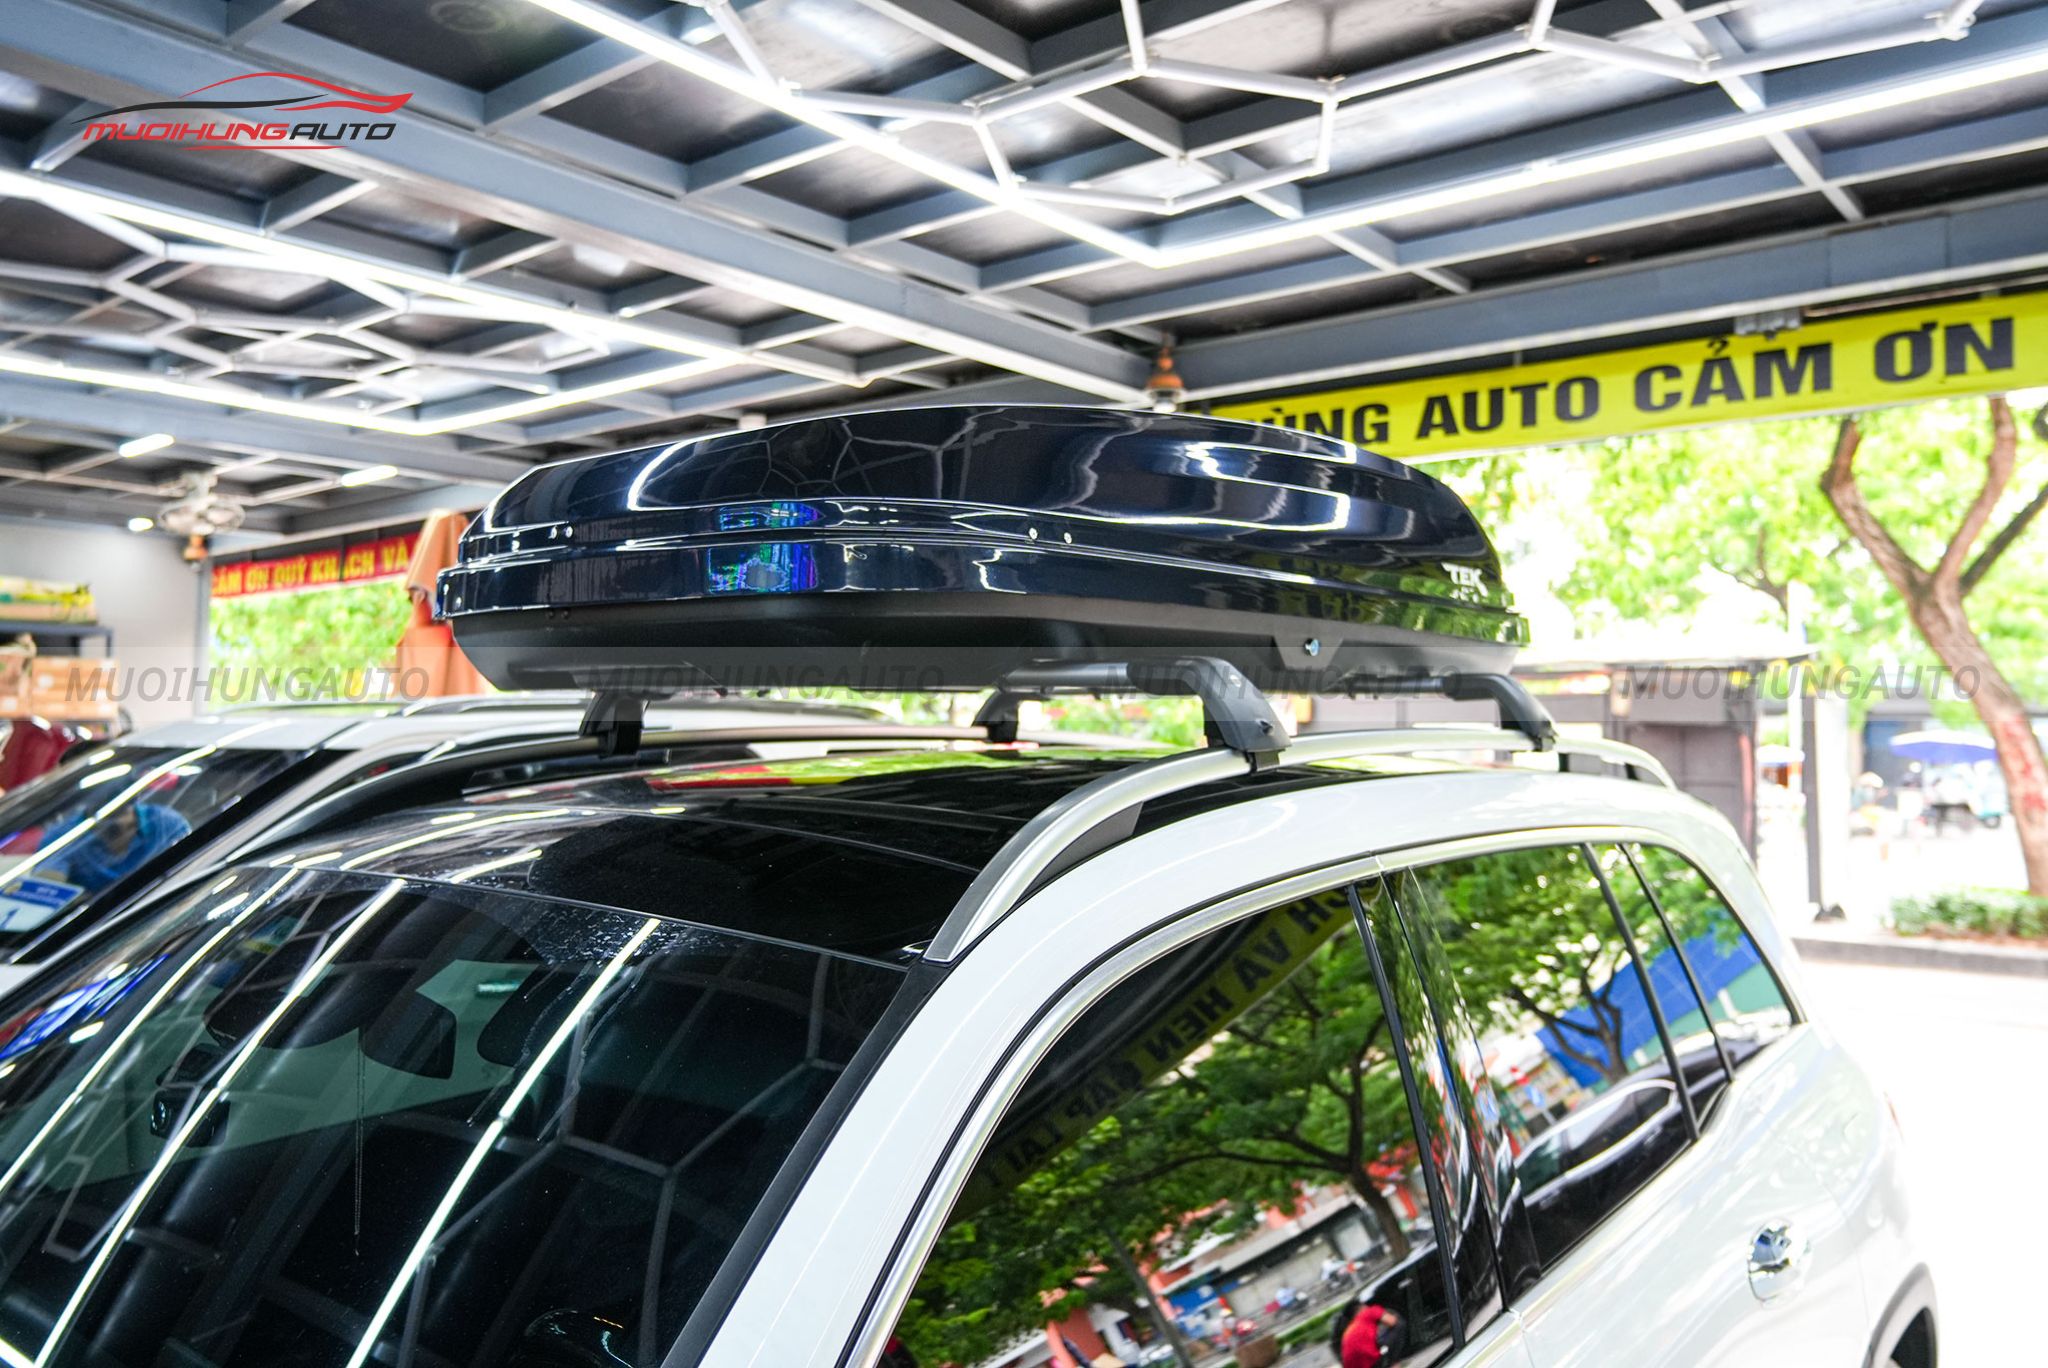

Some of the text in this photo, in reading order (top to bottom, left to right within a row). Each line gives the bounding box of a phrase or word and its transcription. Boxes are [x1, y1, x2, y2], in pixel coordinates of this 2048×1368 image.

[1415, 376, 1601, 440] AUTO
[1634, 335, 1833, 413] CẢM
[1874, 316, 2014, 383] ƠN
